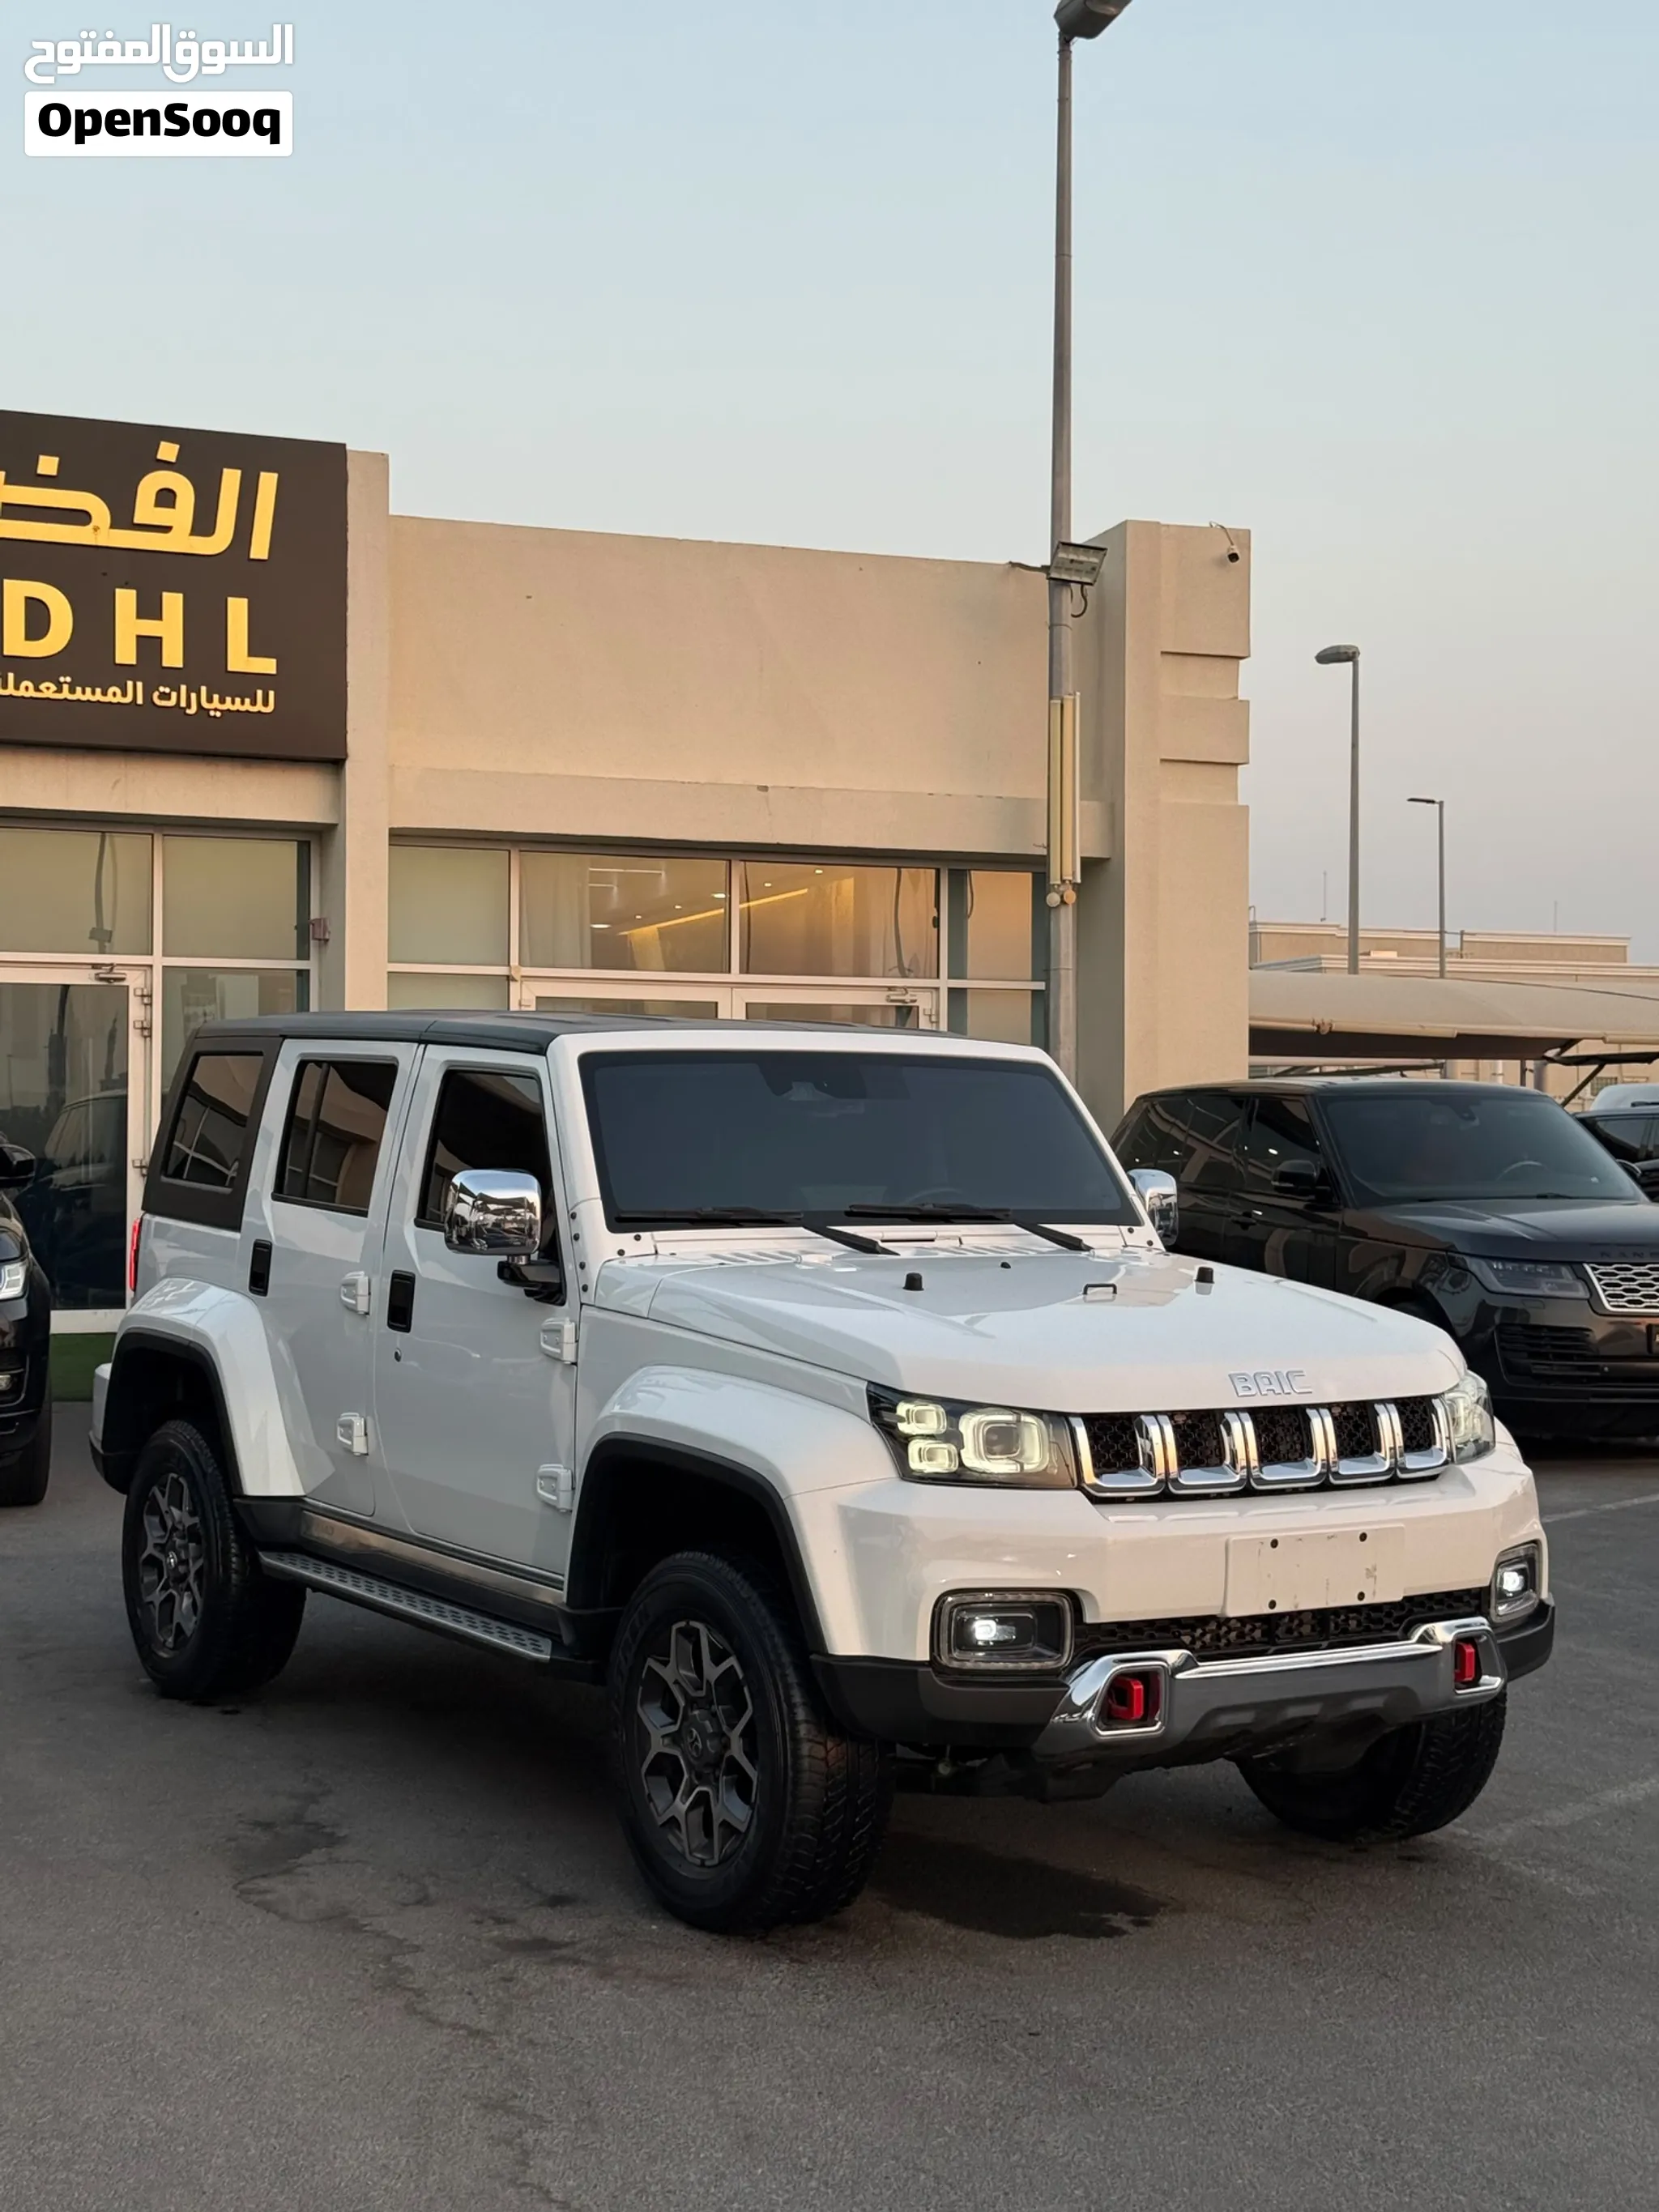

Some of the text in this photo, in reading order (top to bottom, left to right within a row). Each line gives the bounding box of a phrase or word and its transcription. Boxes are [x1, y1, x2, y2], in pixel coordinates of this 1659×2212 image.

[0, 441, 279, 560] الفض
[0, 671, 275, 718] للسيارات المستعمل
[1228, 1370, 1313, 1398] BAIC
